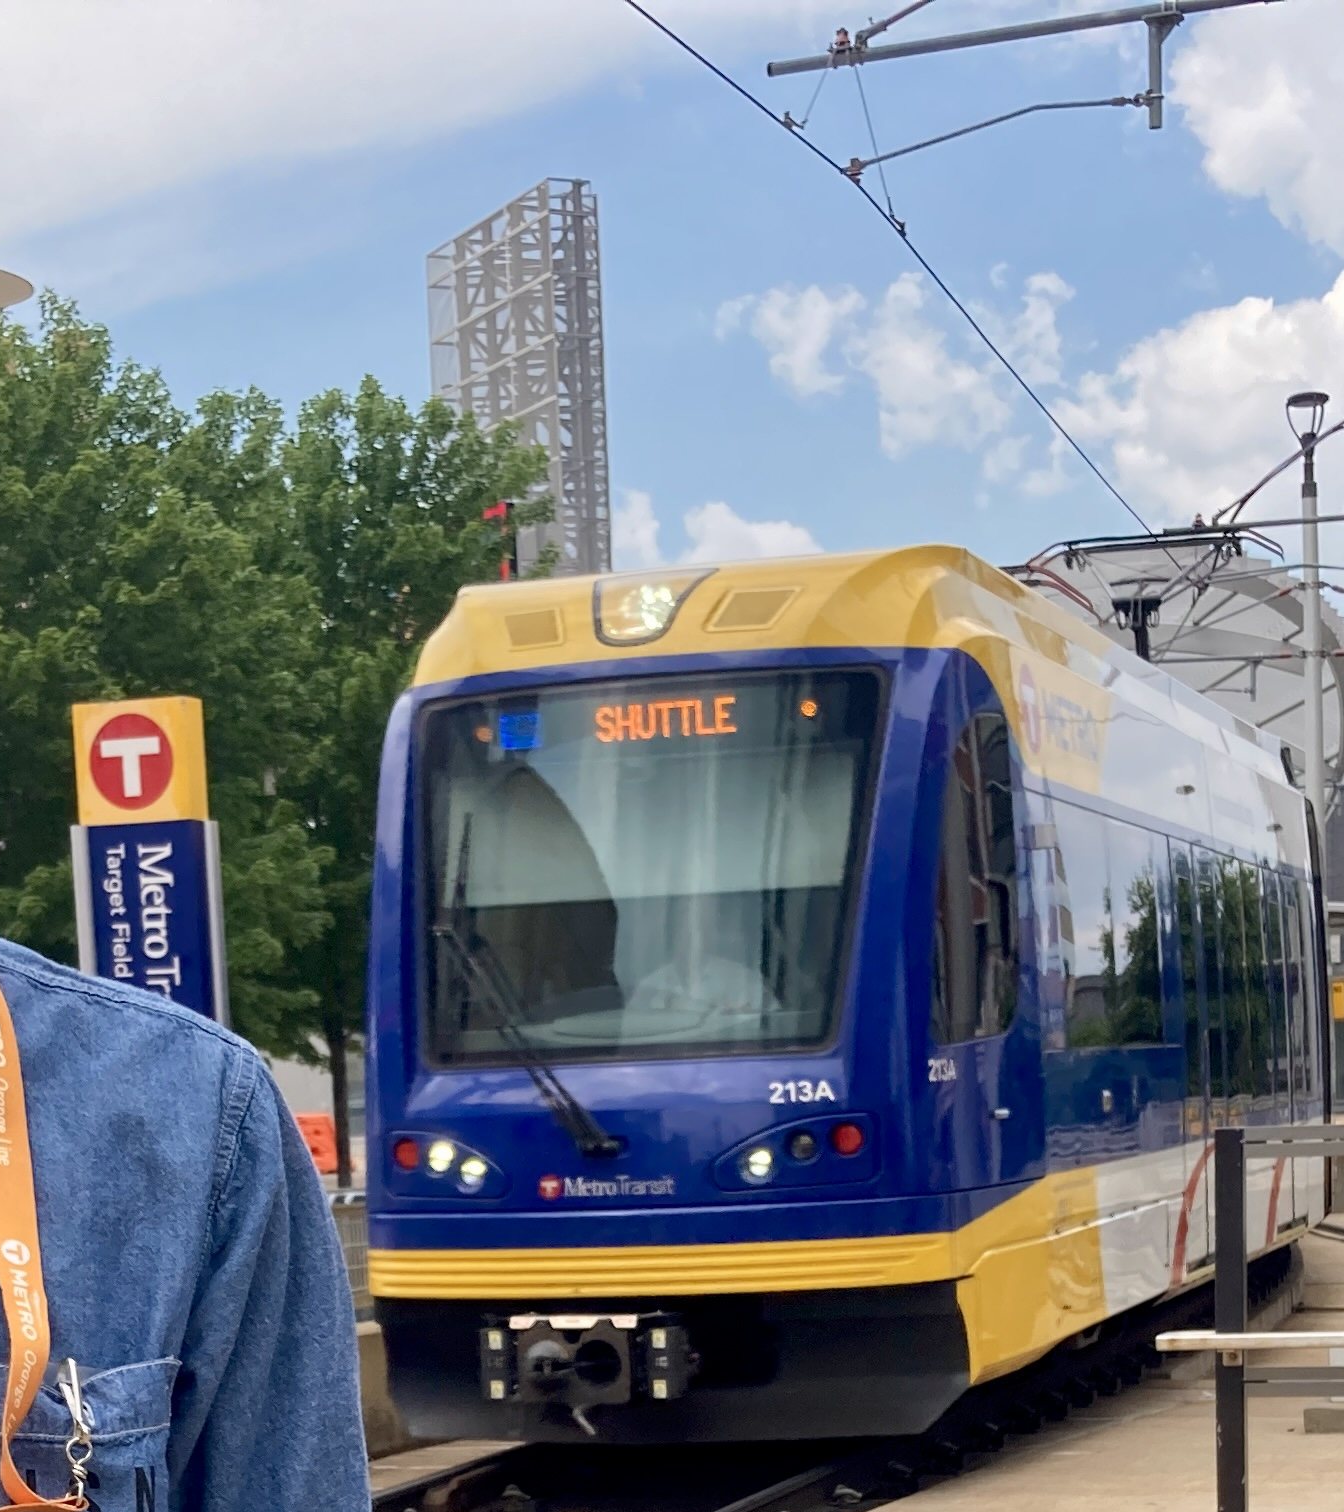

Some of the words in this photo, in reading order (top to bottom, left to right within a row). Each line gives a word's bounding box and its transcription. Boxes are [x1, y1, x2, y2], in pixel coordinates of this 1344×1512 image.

[595, 696, 737, 743] SHUTTLE
[99, 736, 161, 798] T
[103, 843, 128, 917] Target
[111, 922, 135, 979] Field
[768, 1080, 836, 1104] 213A
[927, 1058, 957, 1083] 213A
[9, 1269, 38, 1342] METRO
[13, 1349, 37, 1409] Orange
